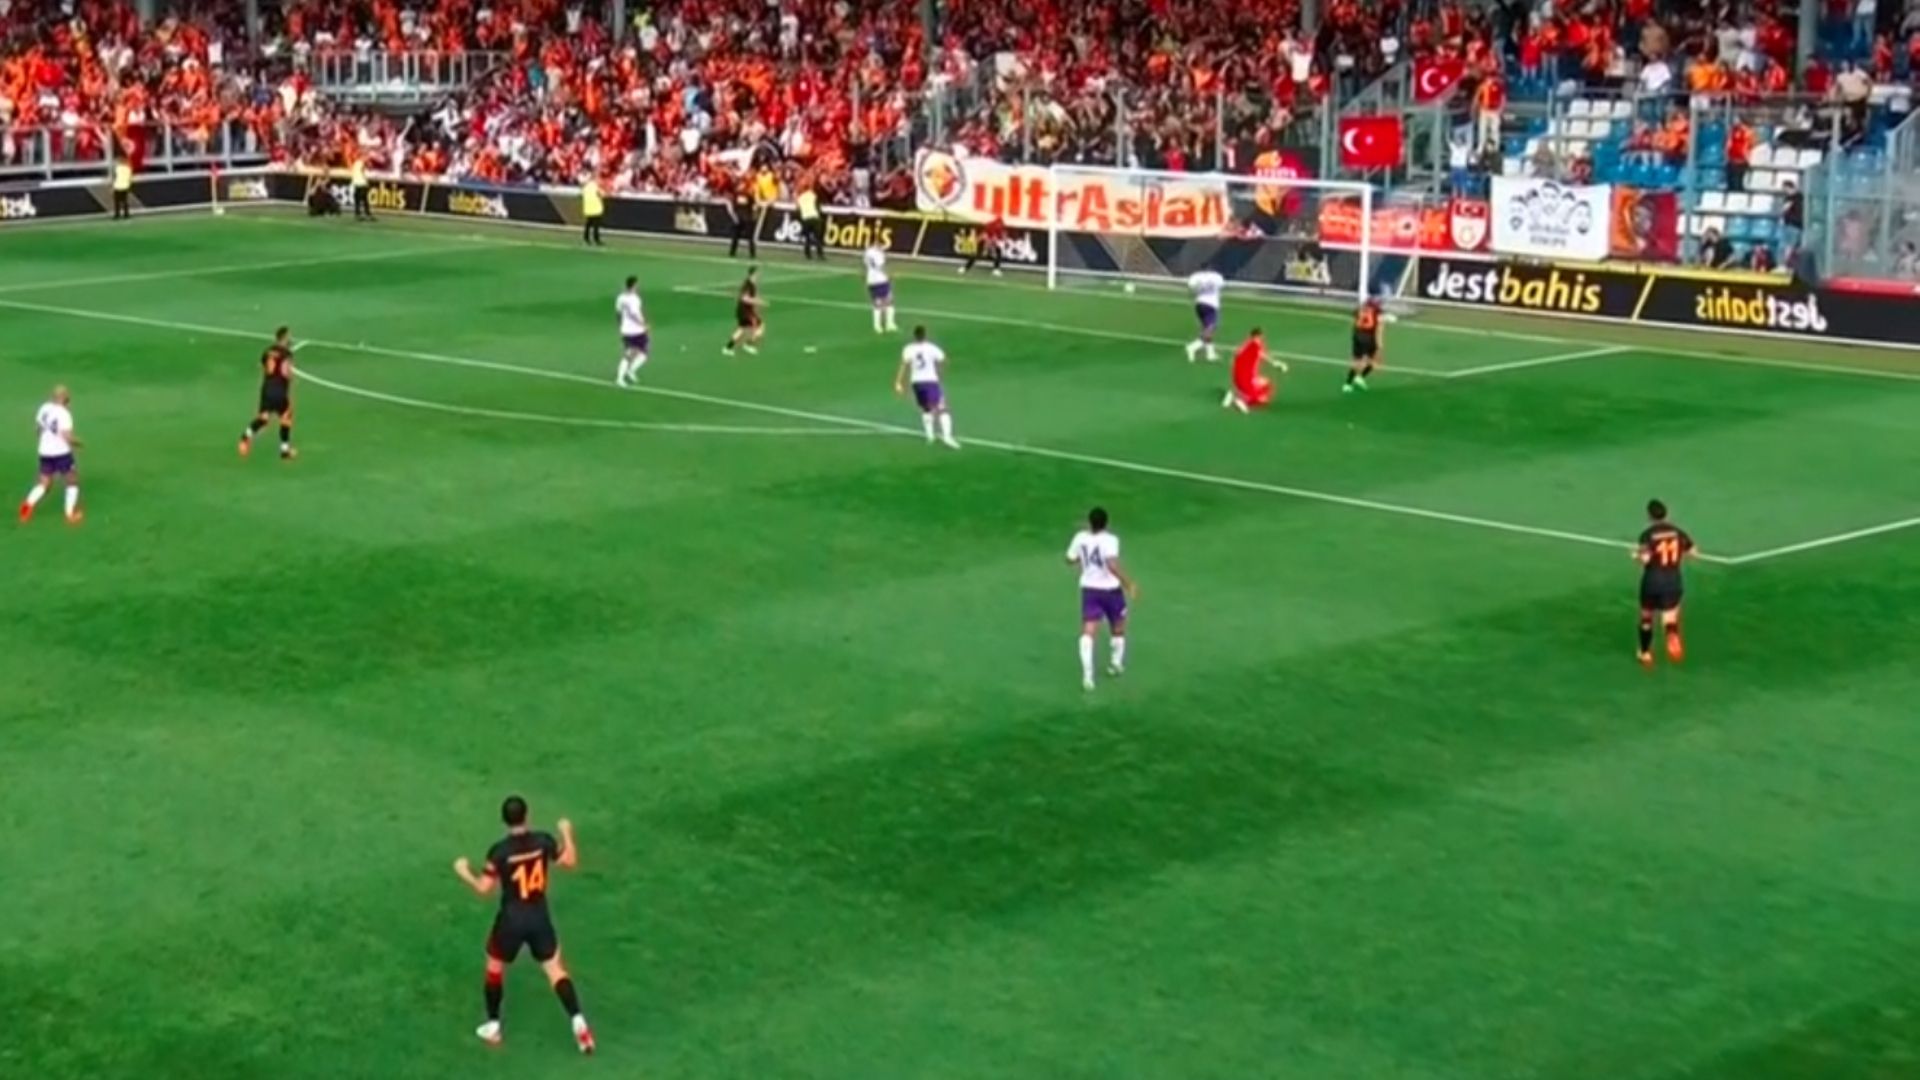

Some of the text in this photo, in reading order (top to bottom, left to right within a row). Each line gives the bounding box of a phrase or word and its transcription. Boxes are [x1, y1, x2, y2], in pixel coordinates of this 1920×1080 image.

[1081, 544, 1104, 569] 14
[1656, 540, 1679, 566] 11
[512, 859, 544, 899] 14
